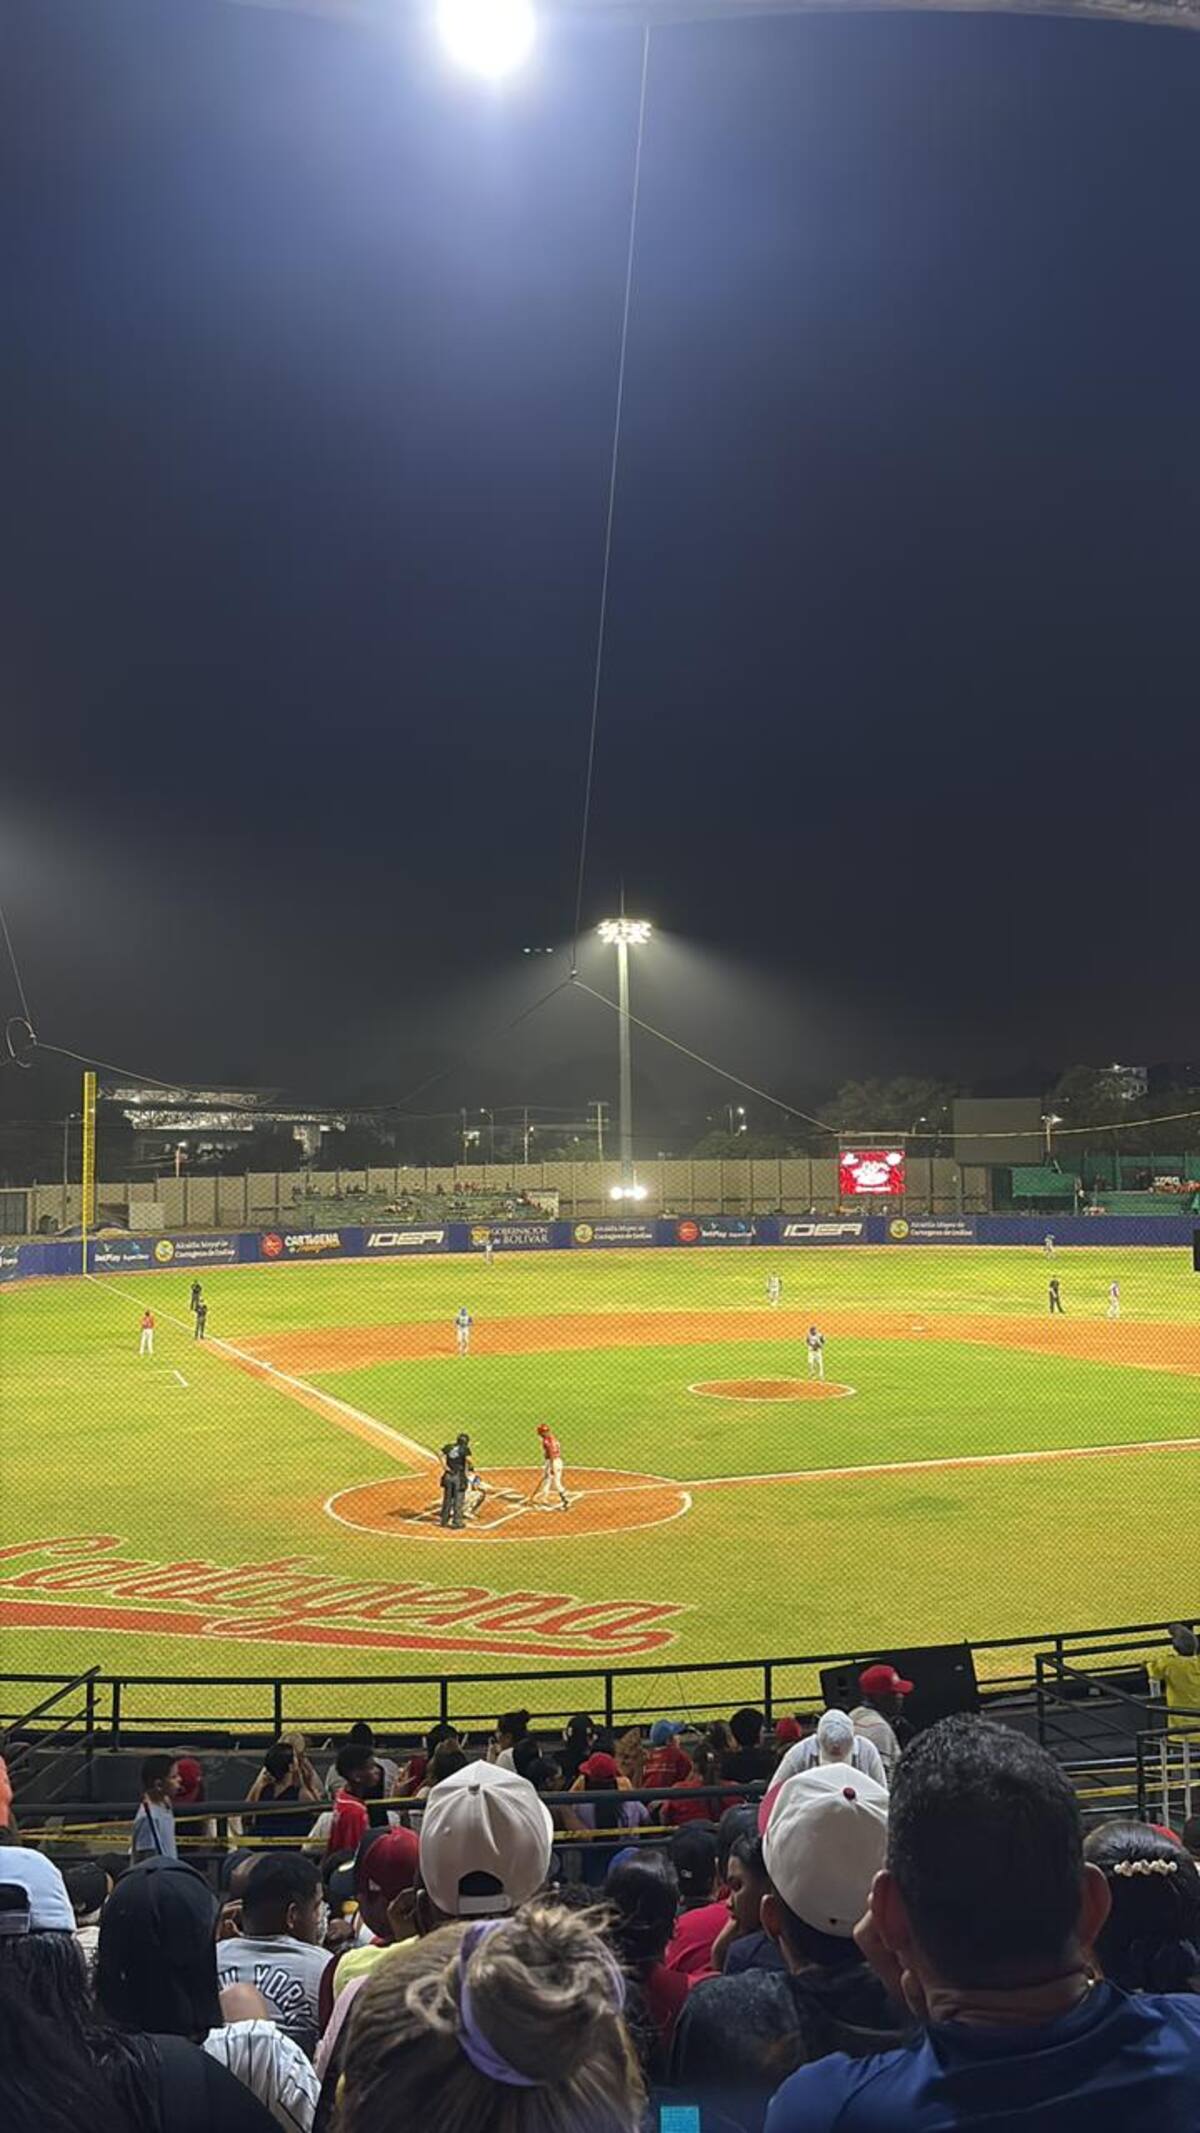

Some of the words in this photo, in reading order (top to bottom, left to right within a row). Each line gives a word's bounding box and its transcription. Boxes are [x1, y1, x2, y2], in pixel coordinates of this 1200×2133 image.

[366, 1230, 445, 1247] IDEA
[783, 1223, 862, 1237] IDEA
[254, 1964, 313, 2026] YORK
